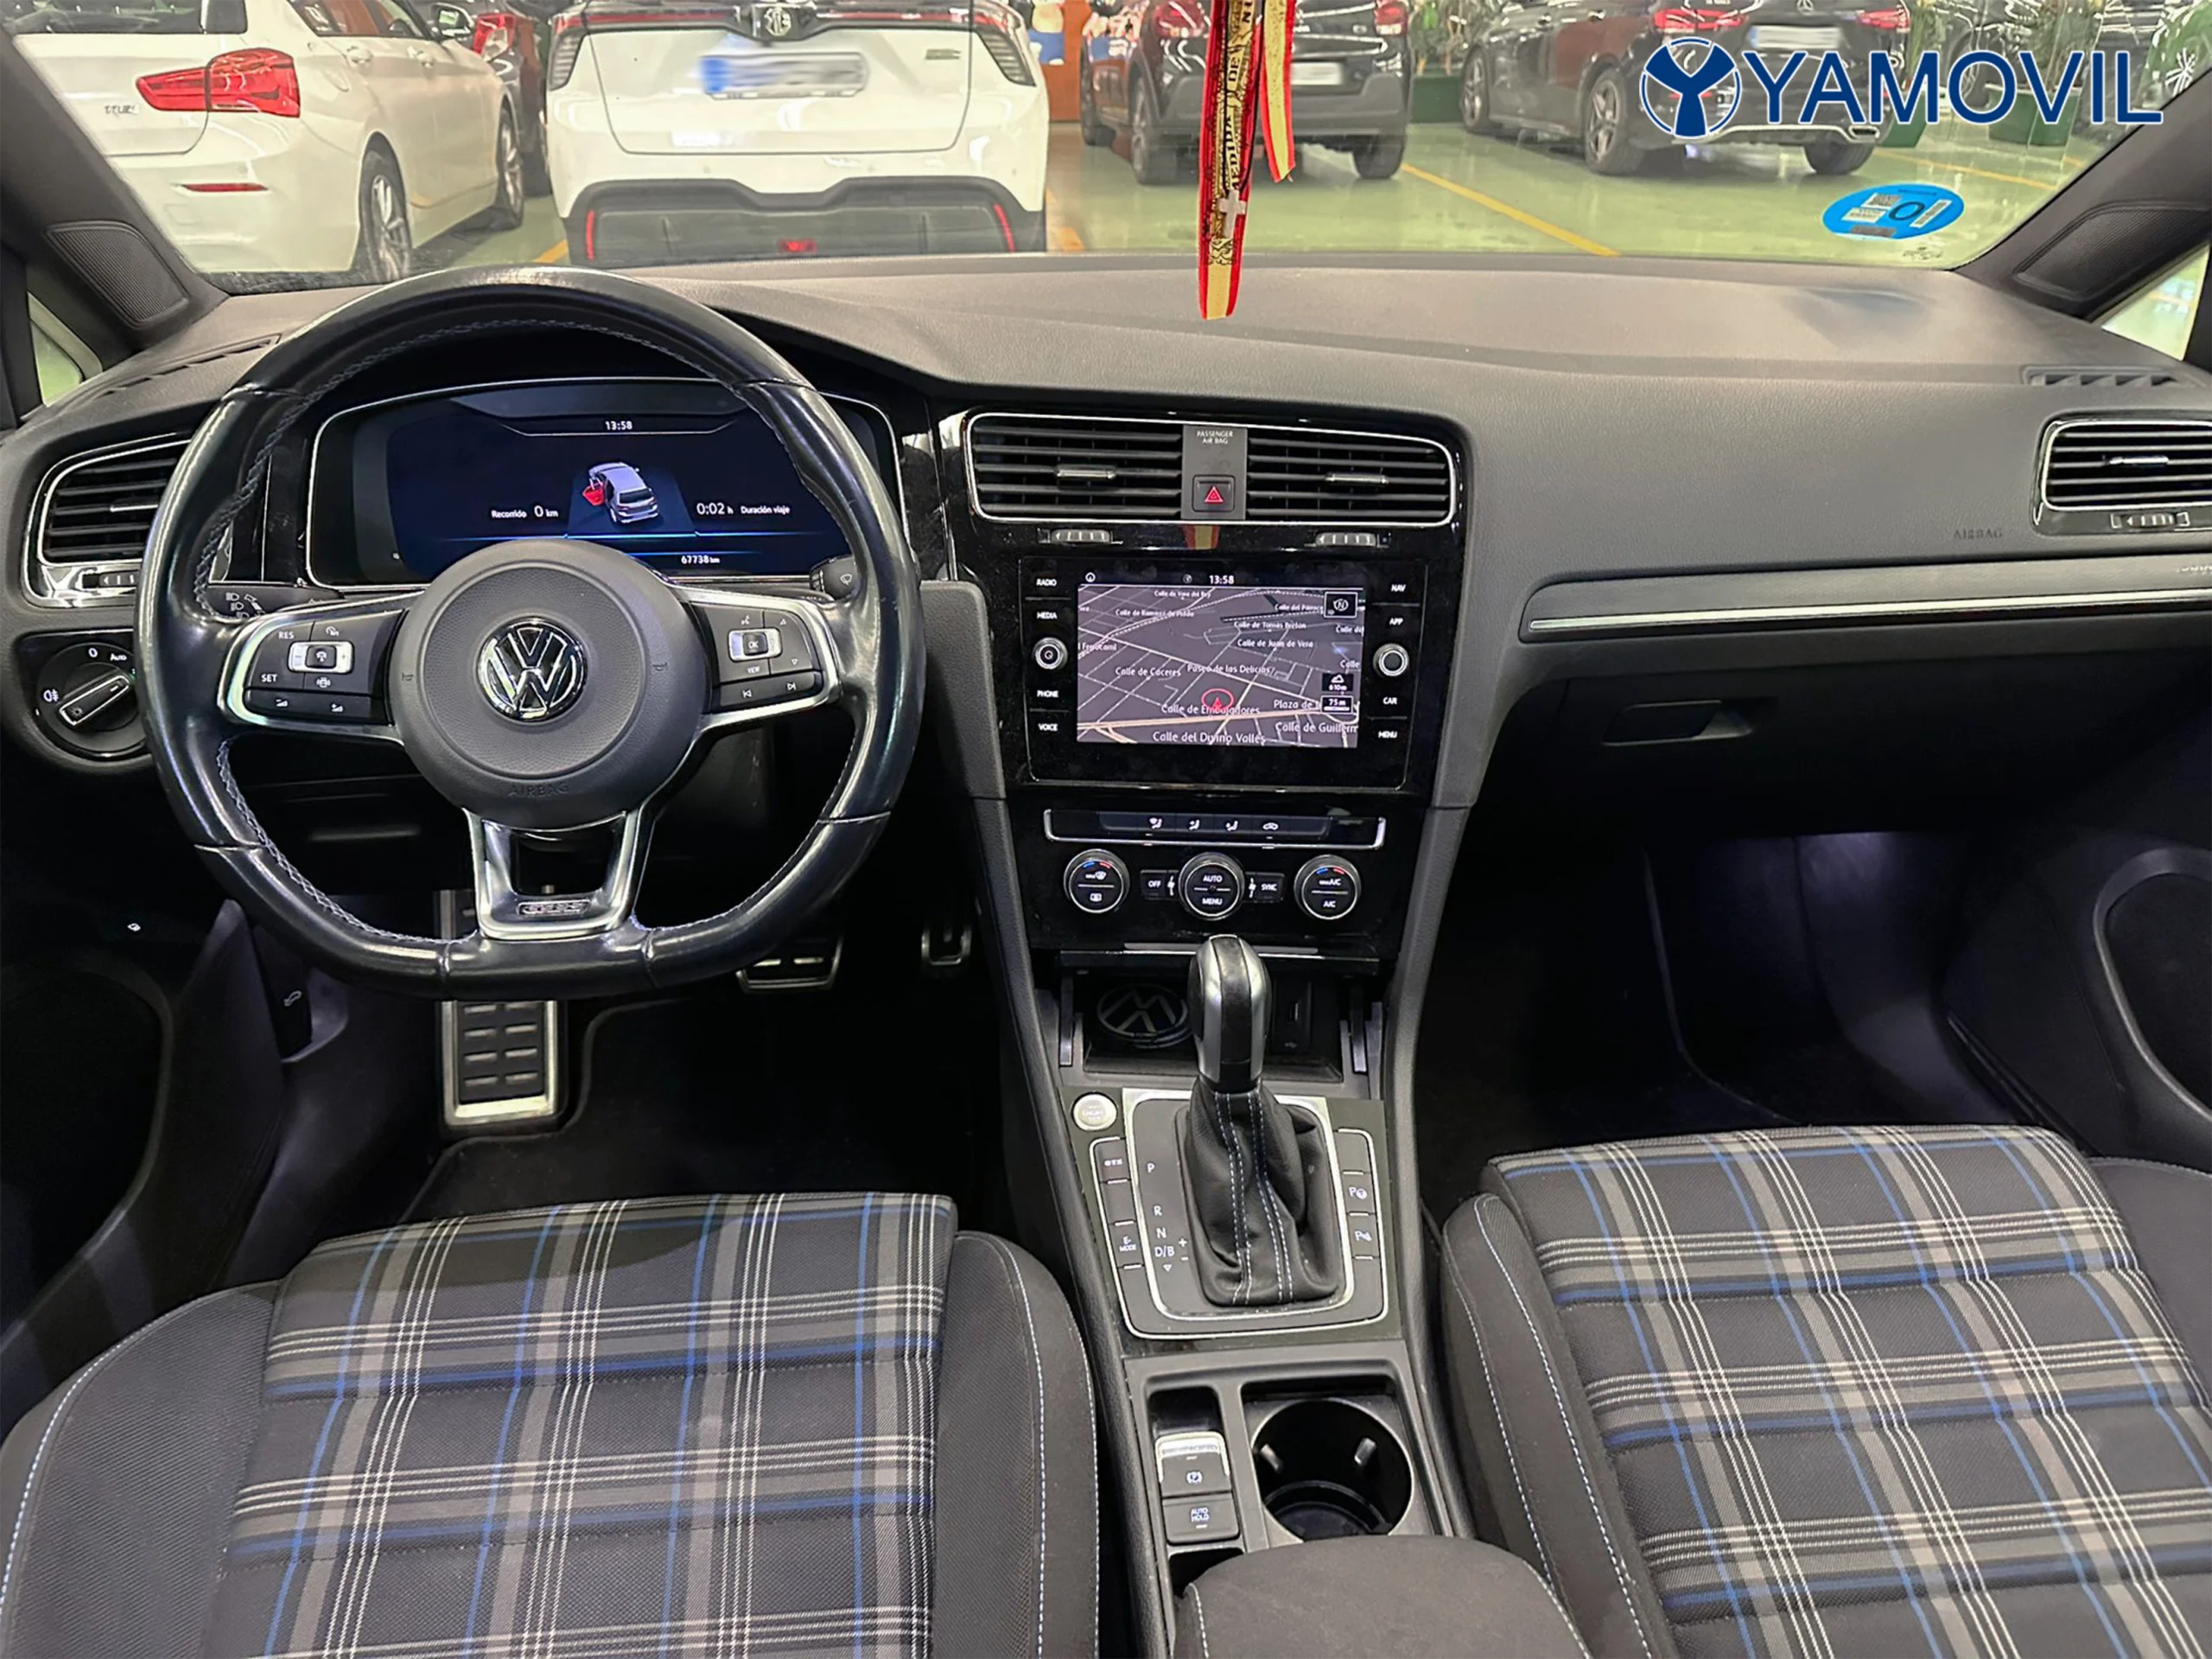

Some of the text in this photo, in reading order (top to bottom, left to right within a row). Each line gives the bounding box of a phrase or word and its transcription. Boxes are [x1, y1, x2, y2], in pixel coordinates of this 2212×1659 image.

[1228, 58, 1241, 82] DE
[605, 421, 633, 431] 13:58
[491, 505, 559, 518] Recorrido 0 km
[696, 502, 791, 516] 0:02 h Duración viaje
[1953, 528, 2003, 540] AIRBAG
[681, 555, 709, 564] 67738
[1036, 578, 1058, 587] RADIO
[1209, 575, 1236, 585] 13:58
[1036, 611, 1058, 620] MEDIA
[1389, 617, 1404, 626] APP
[278, 631, 295, 640] RES
[747, 639, 760, 649] OK
[1237, 639, 1255, 647] Calle
[1212, 664, 1224, 673] de
[1225, 665, 1237, 674] las
[1340, 659, 1361, 669] Calle
[1115, 666, 1133, 676] Calle
[1137, 668, 1148, 677] de
[261, 673, 278, 683] SET
[1274, 699, 1298, 709] Plaza
[1300, 700, 1313, 709] de
[1382, 696, 1398, 705] CAR
[1161, 704, 1185, 715] Calle
[1186, 704, 1198, 715] de
[1038, 722, 1058, 732] VOICE
[1303, 722, 1316, 733] de
[1153, 731, 1179, 743] Calle
[1180, 732, 1197, 743] del
[1377, 730, 1398, 740] MENU
[508, 782, 570, 799] AIRBAG
[1202, 874, 1224, 883] AUTO
[1147, 880, 1162, 888] OFF
[1261, 883, 1278, 892] SYNC
[1202, 897, 1224, 906] MENU
[1147, 1162, 1156, 1173] P
[1154, 1205, 1163, 1217] R
[1156, 1227, 1167, 1239] N
[1119, 1243, 1137, 1252] MODE
[1154, 1245, 1175, 1258] D/B
[1191, 1513, 1211, 1522] HOLD
